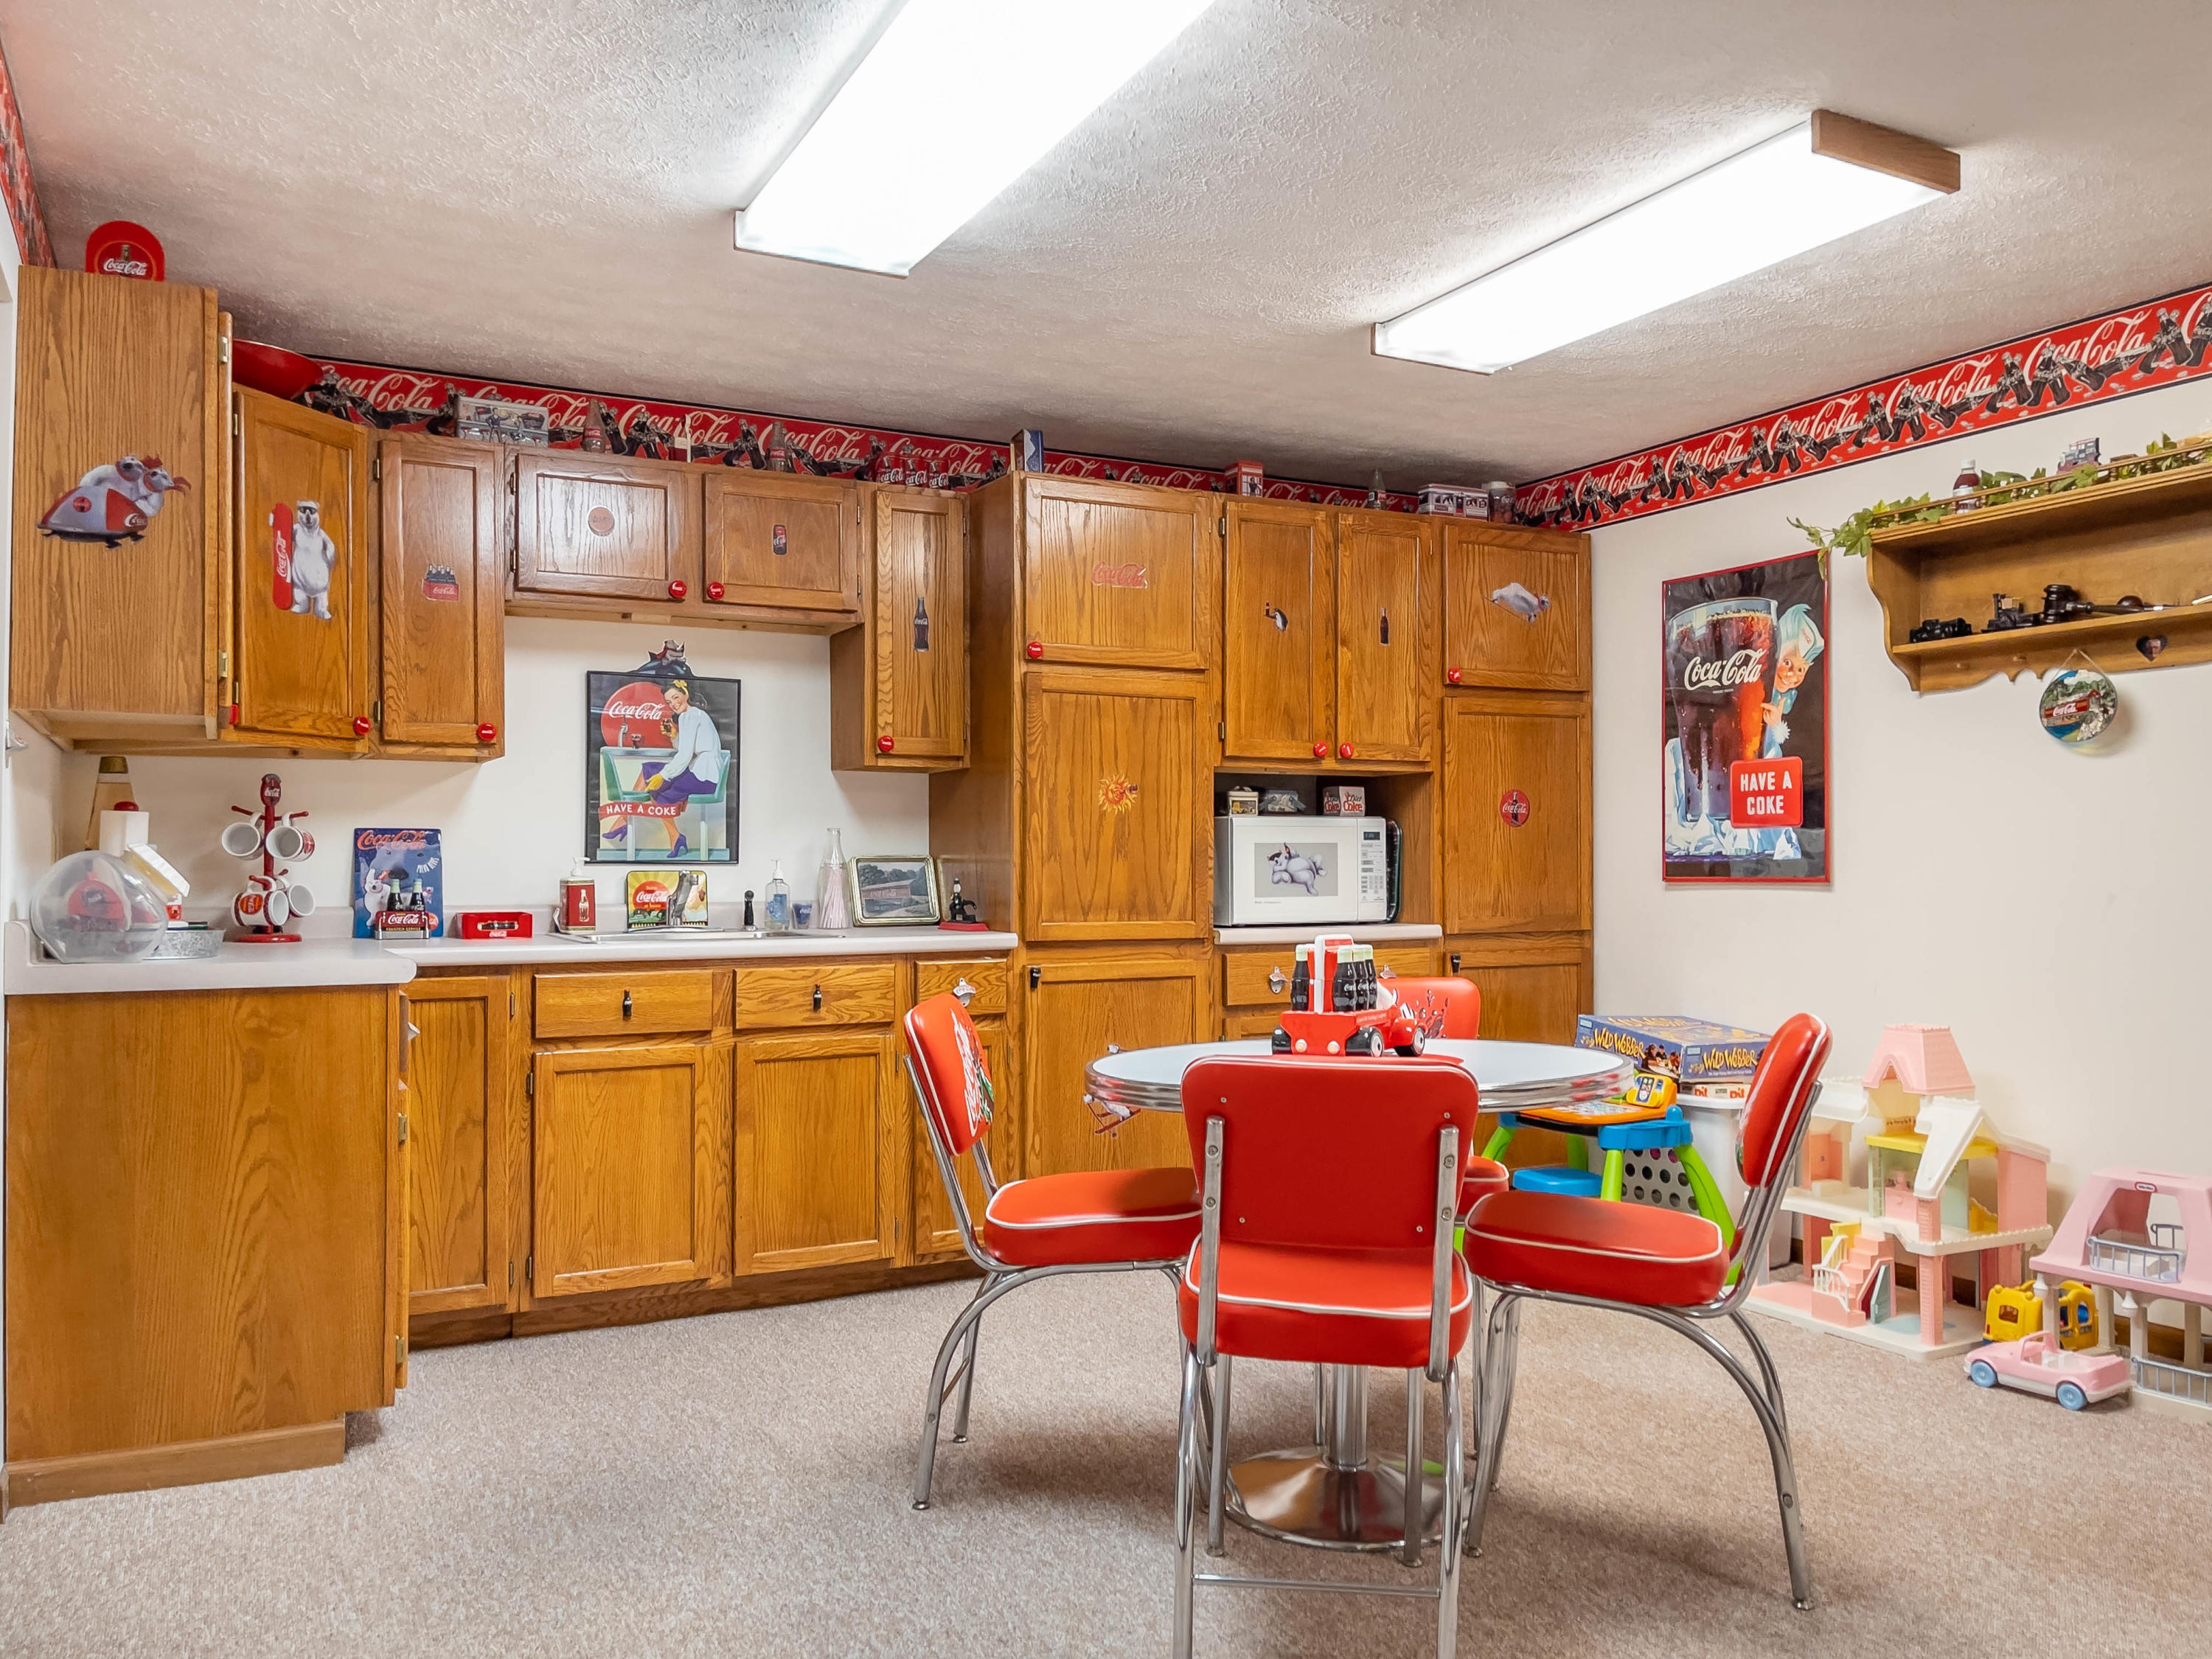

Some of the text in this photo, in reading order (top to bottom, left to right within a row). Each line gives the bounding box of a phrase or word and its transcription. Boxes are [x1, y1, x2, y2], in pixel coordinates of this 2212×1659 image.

[104, 258, 147, 276] Coca-Cola
[1684, 649, 1767, 691] Coca-Cola
[609, 701, 665, 720] Coca-Cola
[1740, 771, 1792, 792] HAVE A
[606, 804, 676, 815] HAVE A COKE
[1747, 795, 1784, 815] COKE
[388, 914, 419, 925] Coca-Cola
